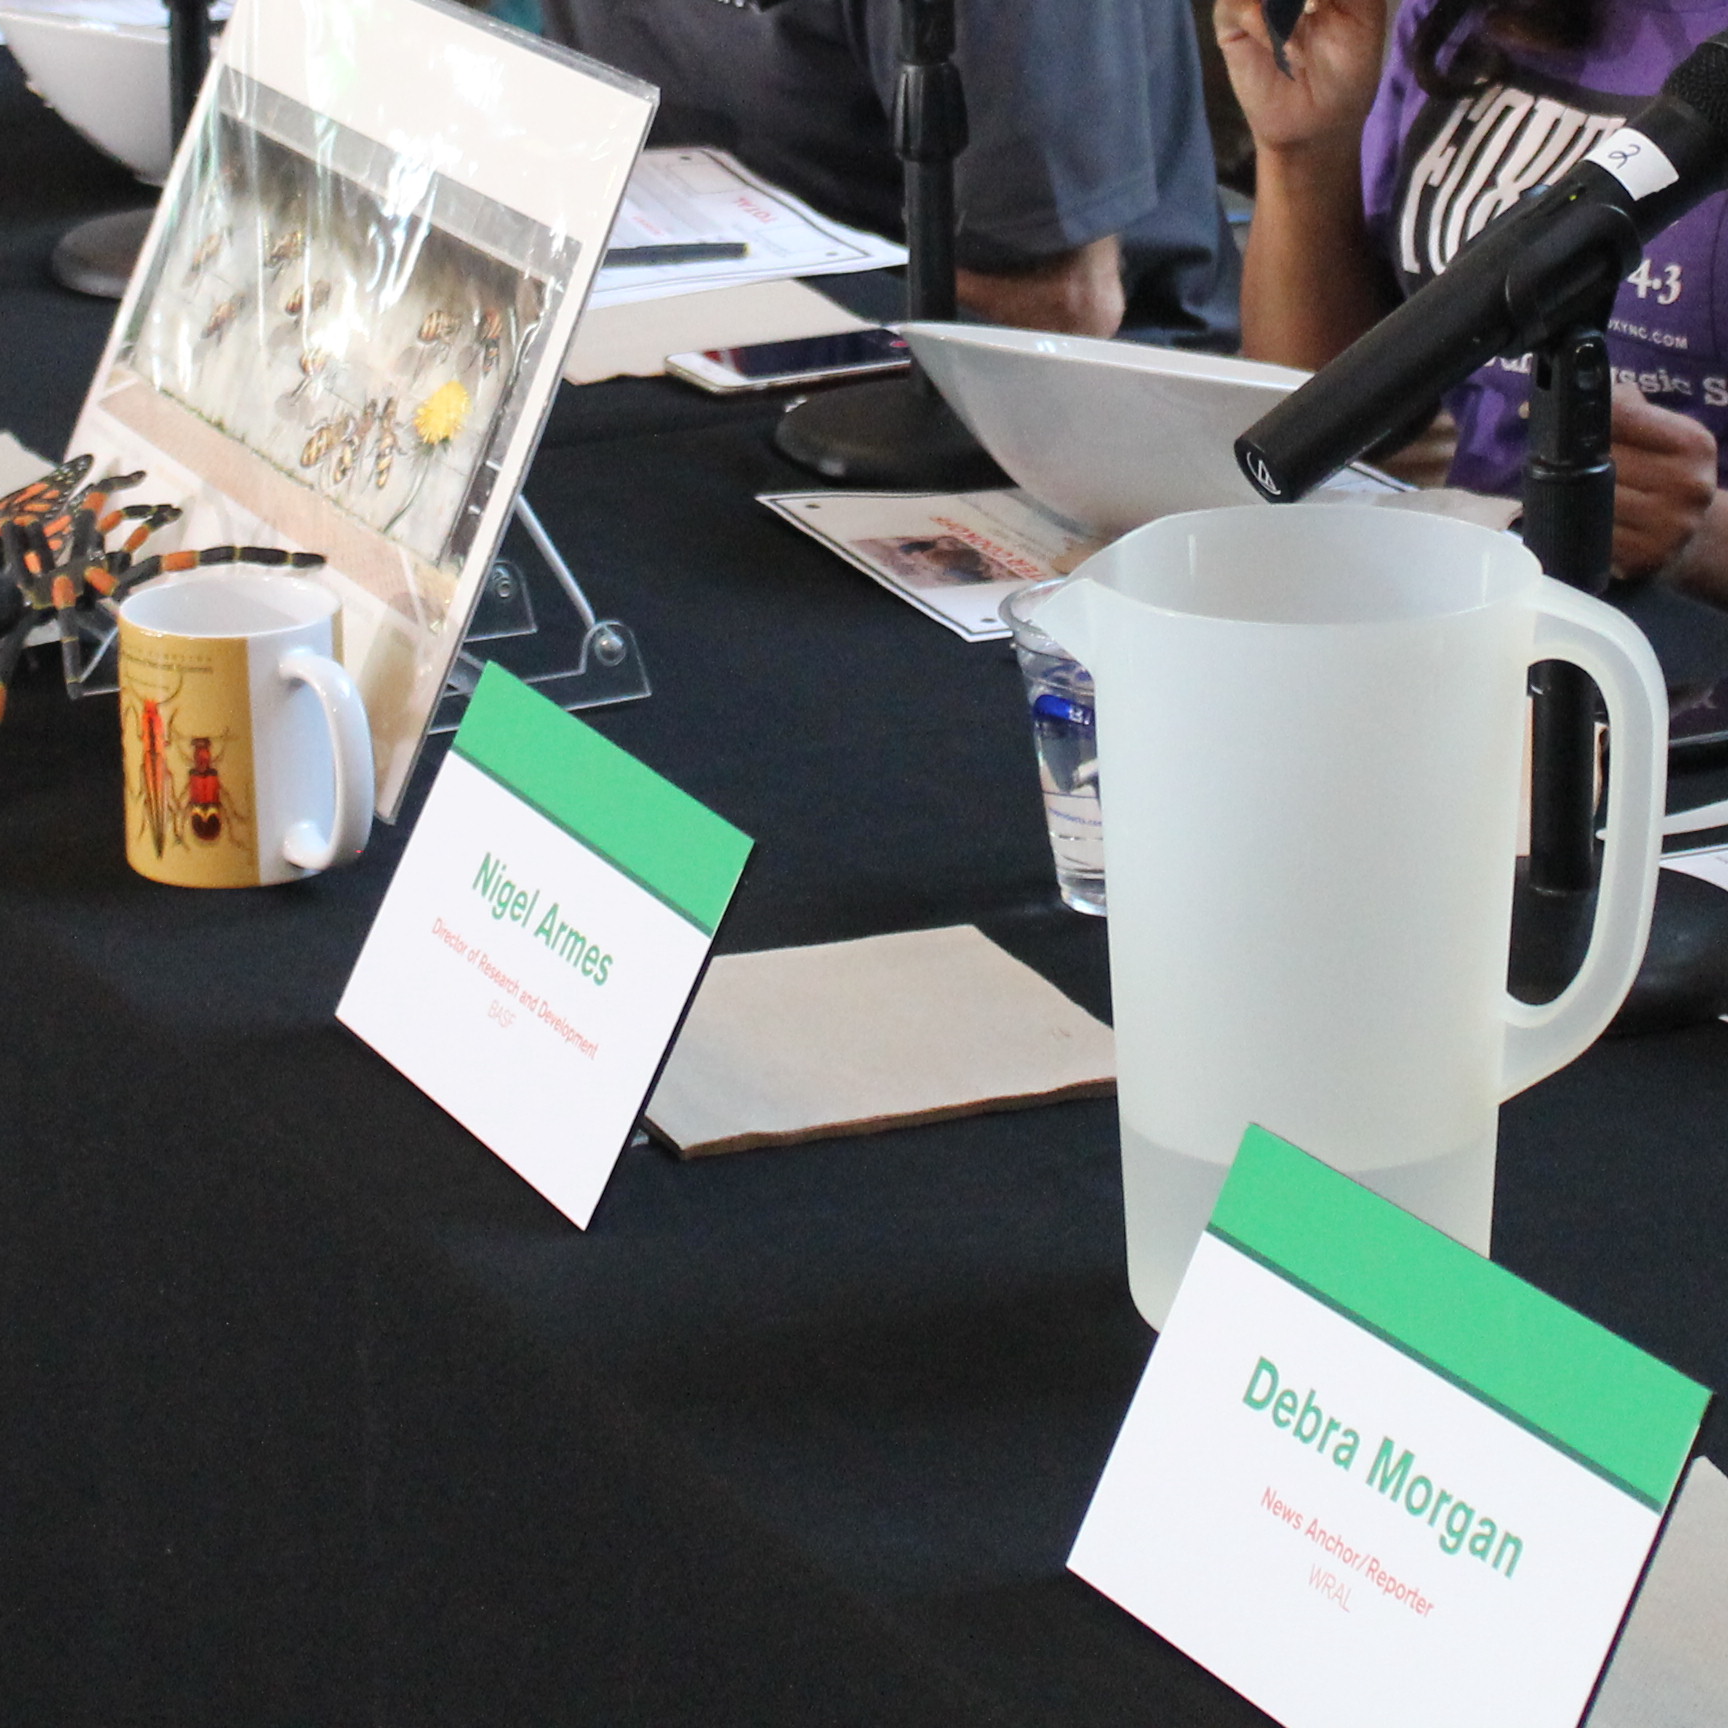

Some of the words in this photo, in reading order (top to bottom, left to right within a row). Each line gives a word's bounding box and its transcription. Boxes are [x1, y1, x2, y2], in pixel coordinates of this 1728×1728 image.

[1611, 365, 1693, 397] ssic
[471, 851, 540, 929] Nigel
[533, 902, 614, 987] Armes
[431, 917, 469, 956] Director
[467, 947, 481, 963] of
[478, 953, 521, 998] Research
[519, 989, 541, 1013] and
[537, 1000, 600, 1061] Development
[487, 999, 517, 1028] BASF
[1241, 1355, 1361, 1472] Debra
[1365, 1434, 1525, 1580] Morgan
[1259, 1485, 1305, 1531] News
[1303, 1517, 1435, 1619] Anchor/Reporter
[1307, 1562, 1352, 1614] WRAL
